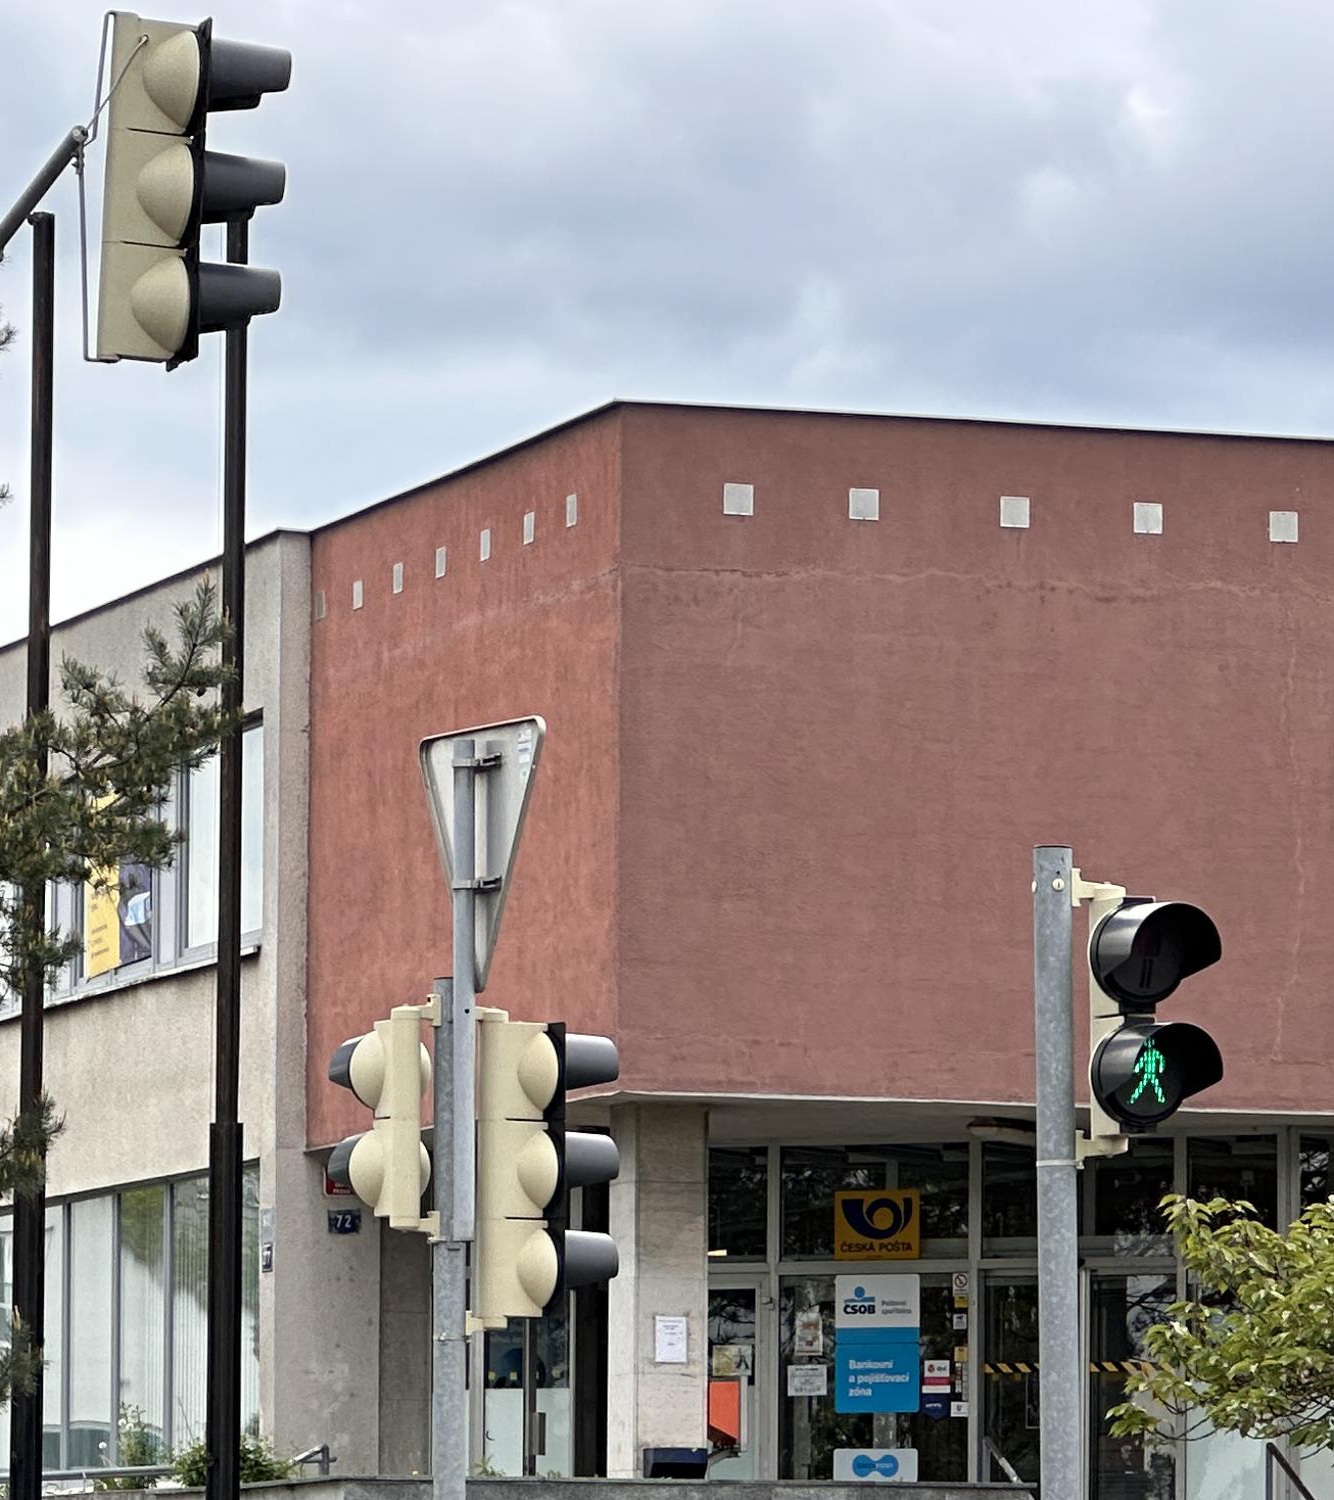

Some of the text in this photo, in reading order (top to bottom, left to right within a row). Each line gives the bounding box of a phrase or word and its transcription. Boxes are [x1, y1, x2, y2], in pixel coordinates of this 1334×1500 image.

[335, 1214, 352, 1228] 72
[840, 1239, 913, 1252] ČESKÁ POŠTA
